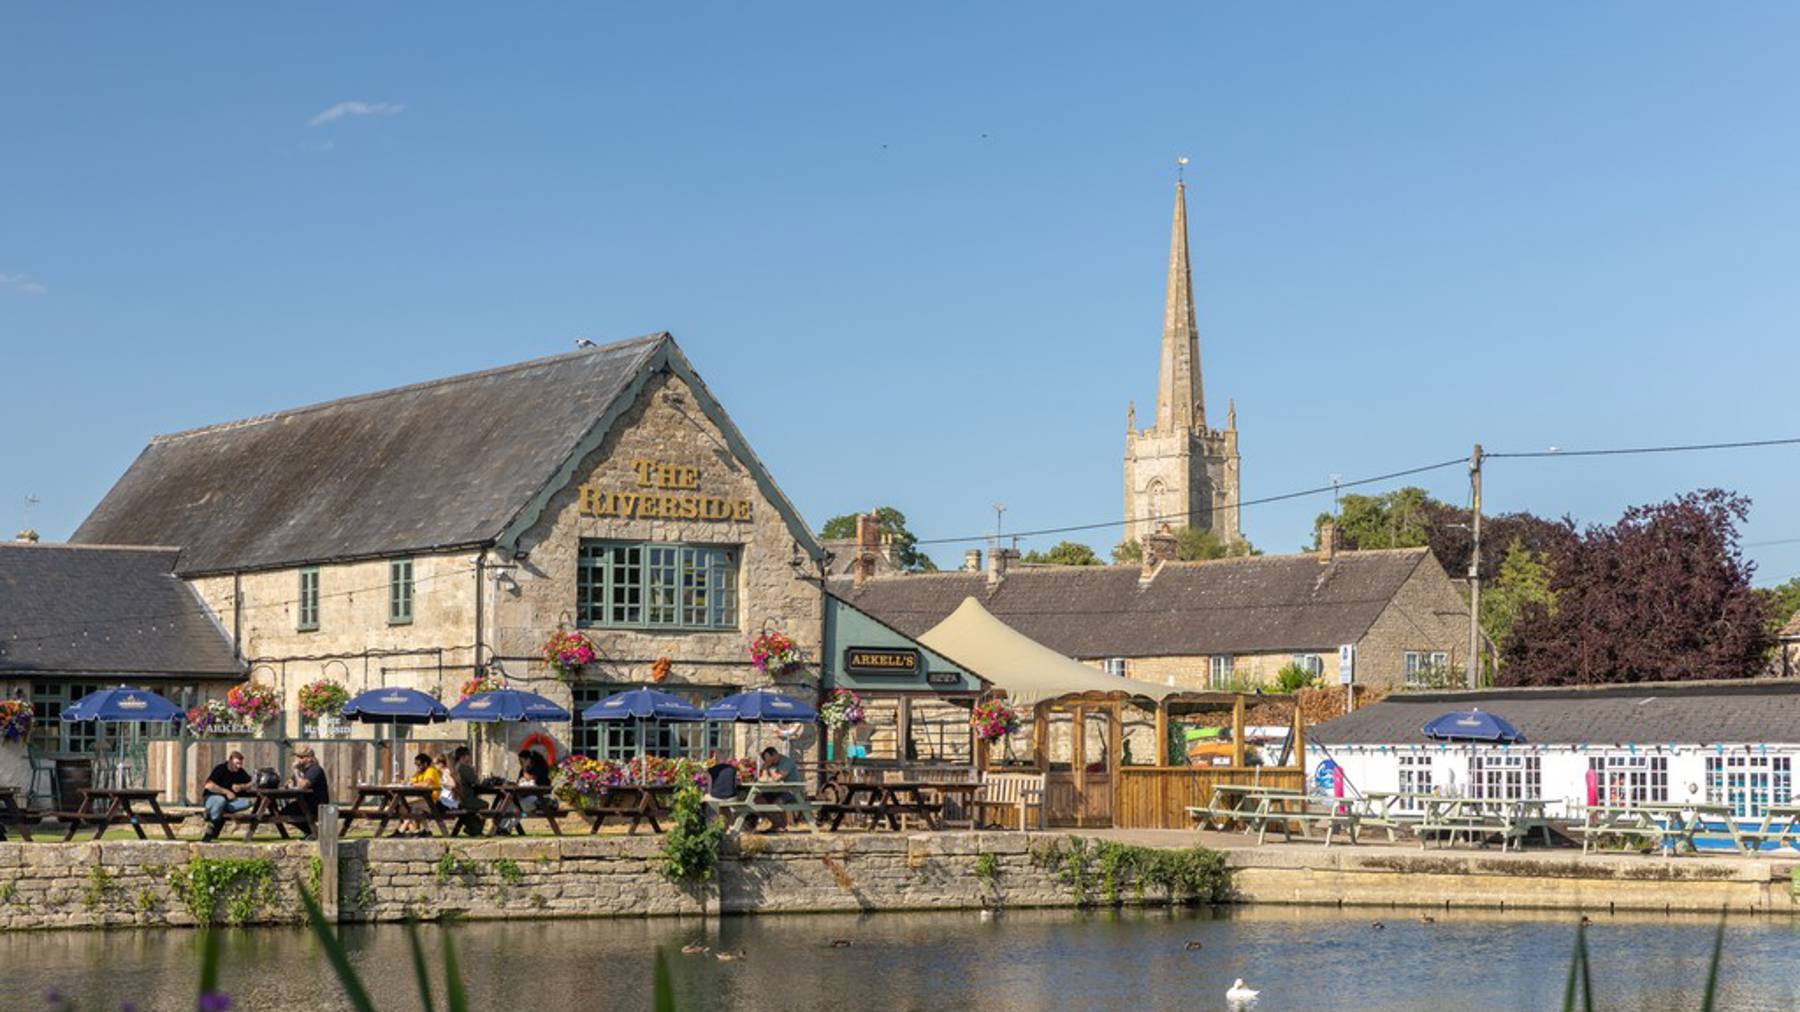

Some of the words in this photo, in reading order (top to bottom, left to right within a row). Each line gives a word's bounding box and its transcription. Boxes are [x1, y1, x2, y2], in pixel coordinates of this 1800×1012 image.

[631, 456, 700, 489] THE
[577, 483, 753, 521] RIVERSIDE
[851, 653, 914, 667] ARKELL'S
